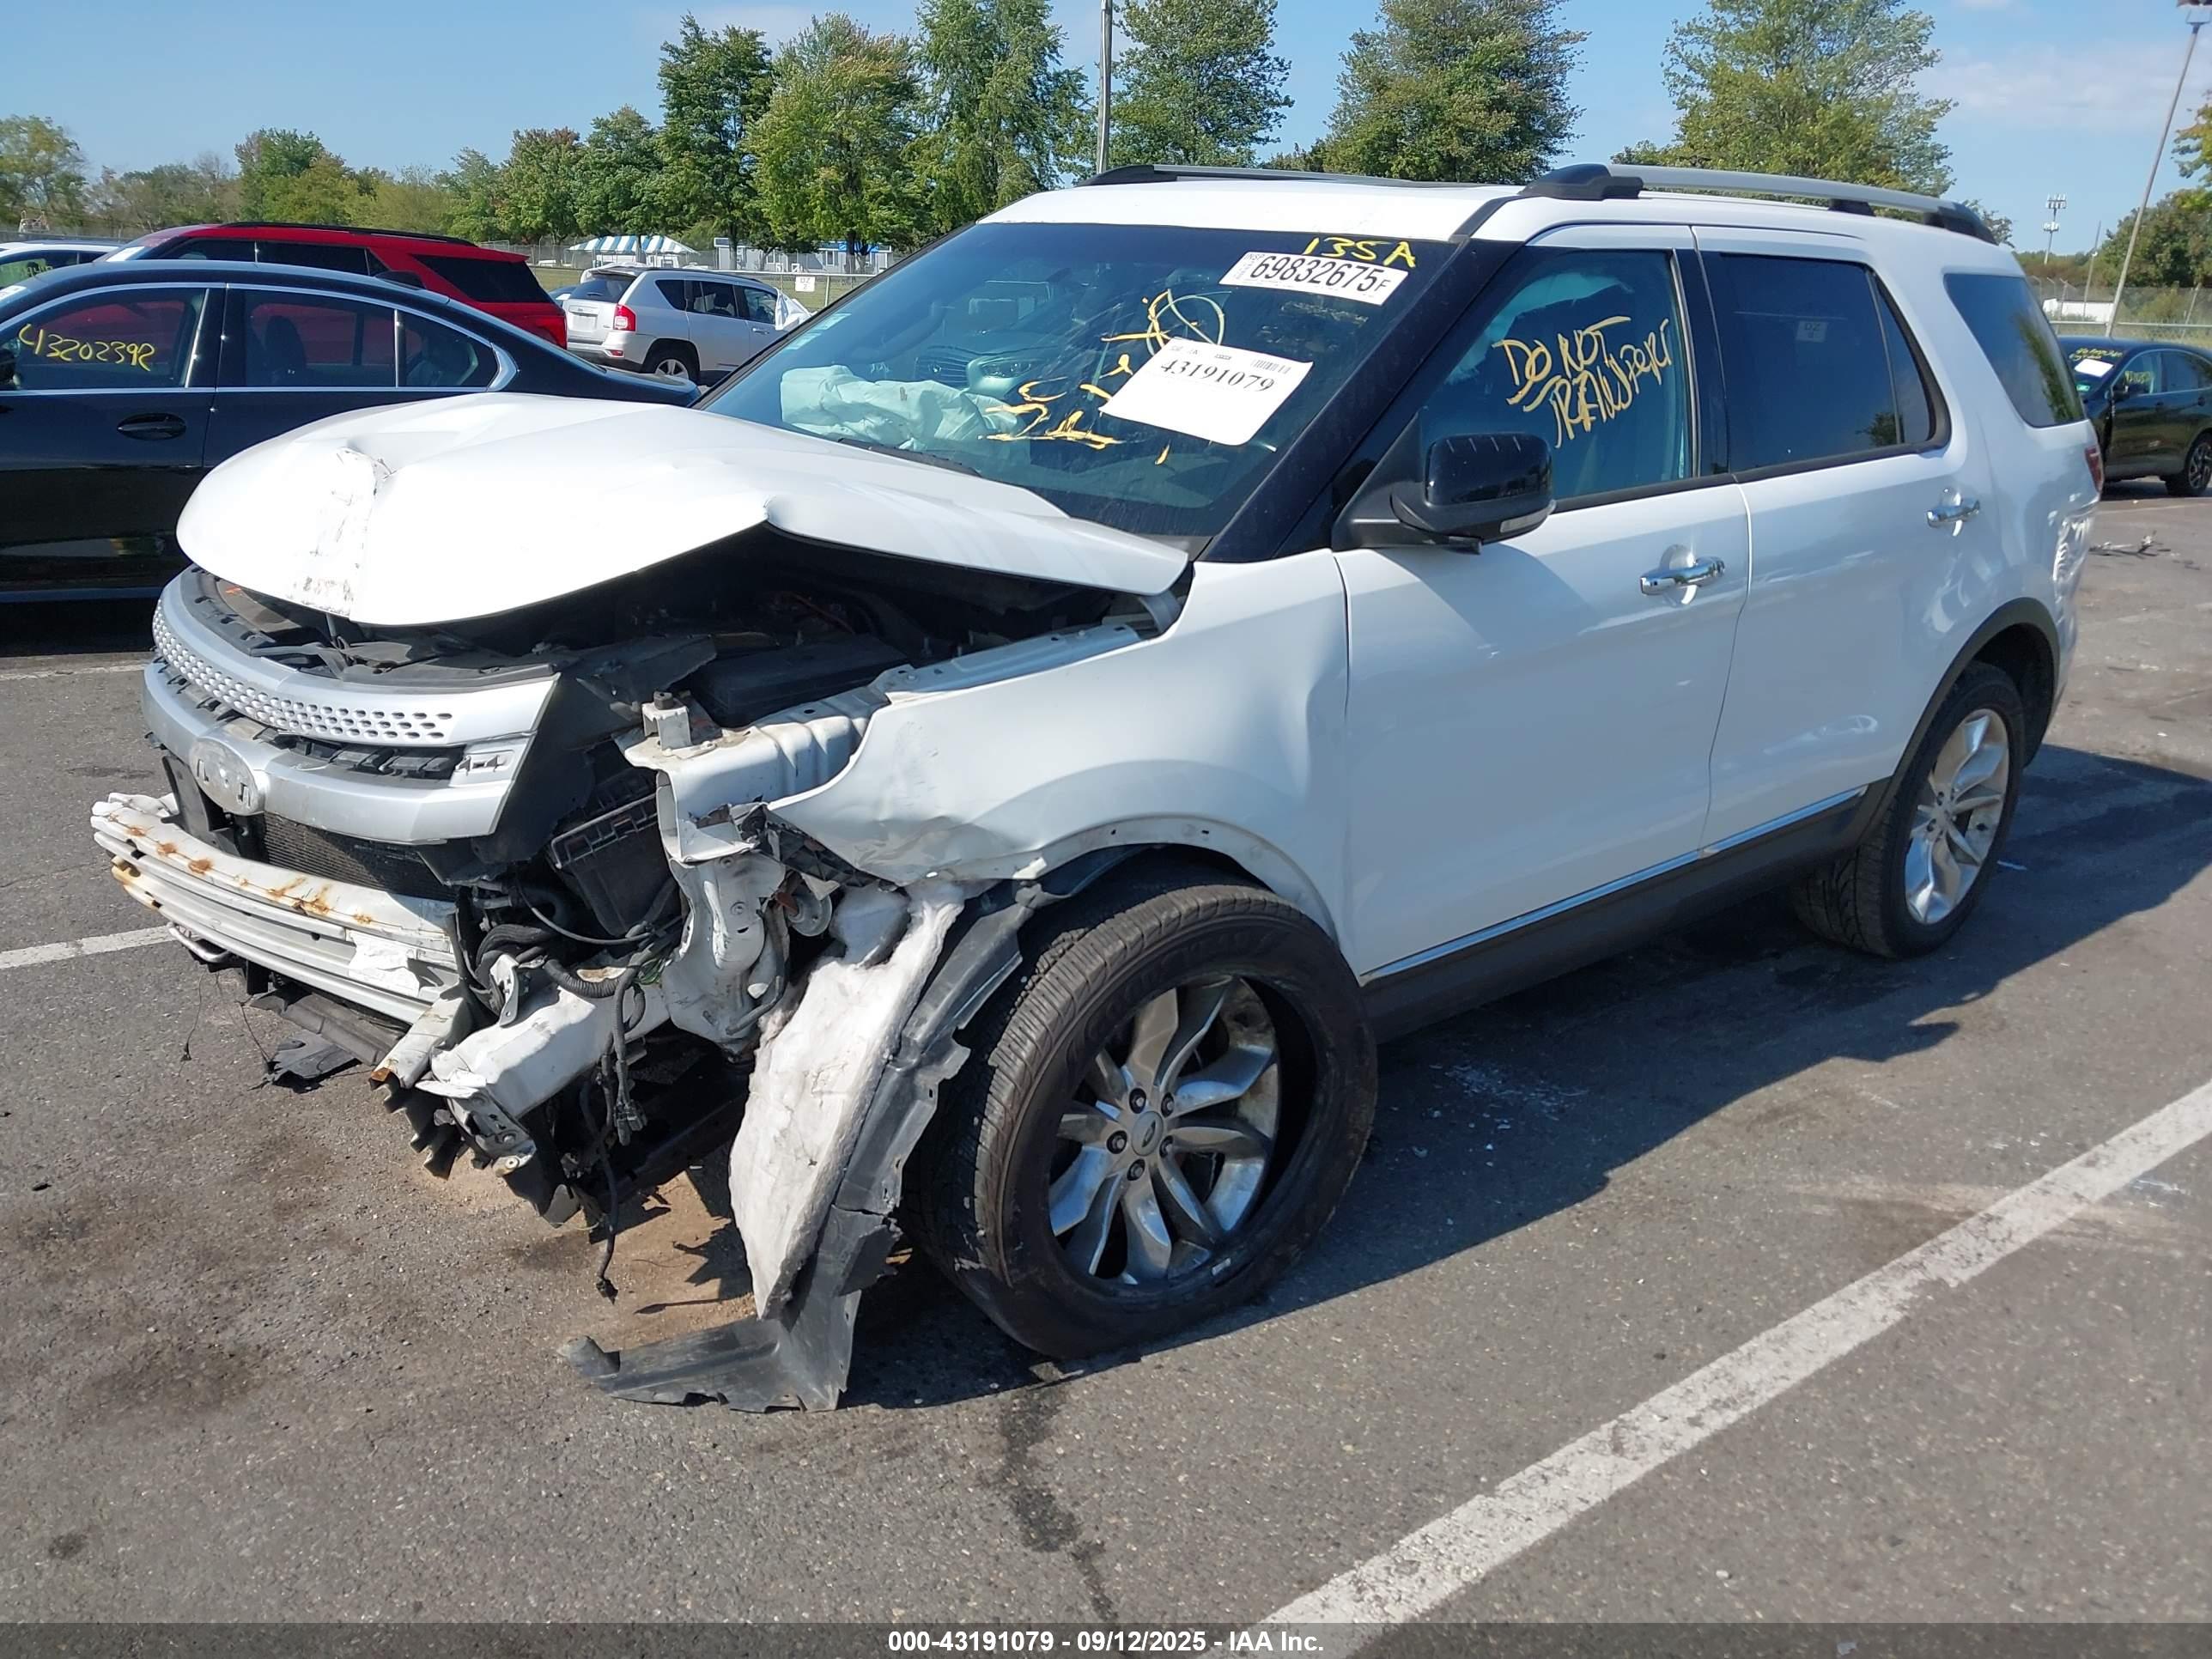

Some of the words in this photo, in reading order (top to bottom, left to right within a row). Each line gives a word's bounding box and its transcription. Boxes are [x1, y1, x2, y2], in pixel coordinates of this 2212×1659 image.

[1249, 256, 1384, 292] 69832675
[18, 323, 155, 372] 43202392
[1557, 315, 1632, 380] NOT
[1160, 359, 1276, 392] 43191079
